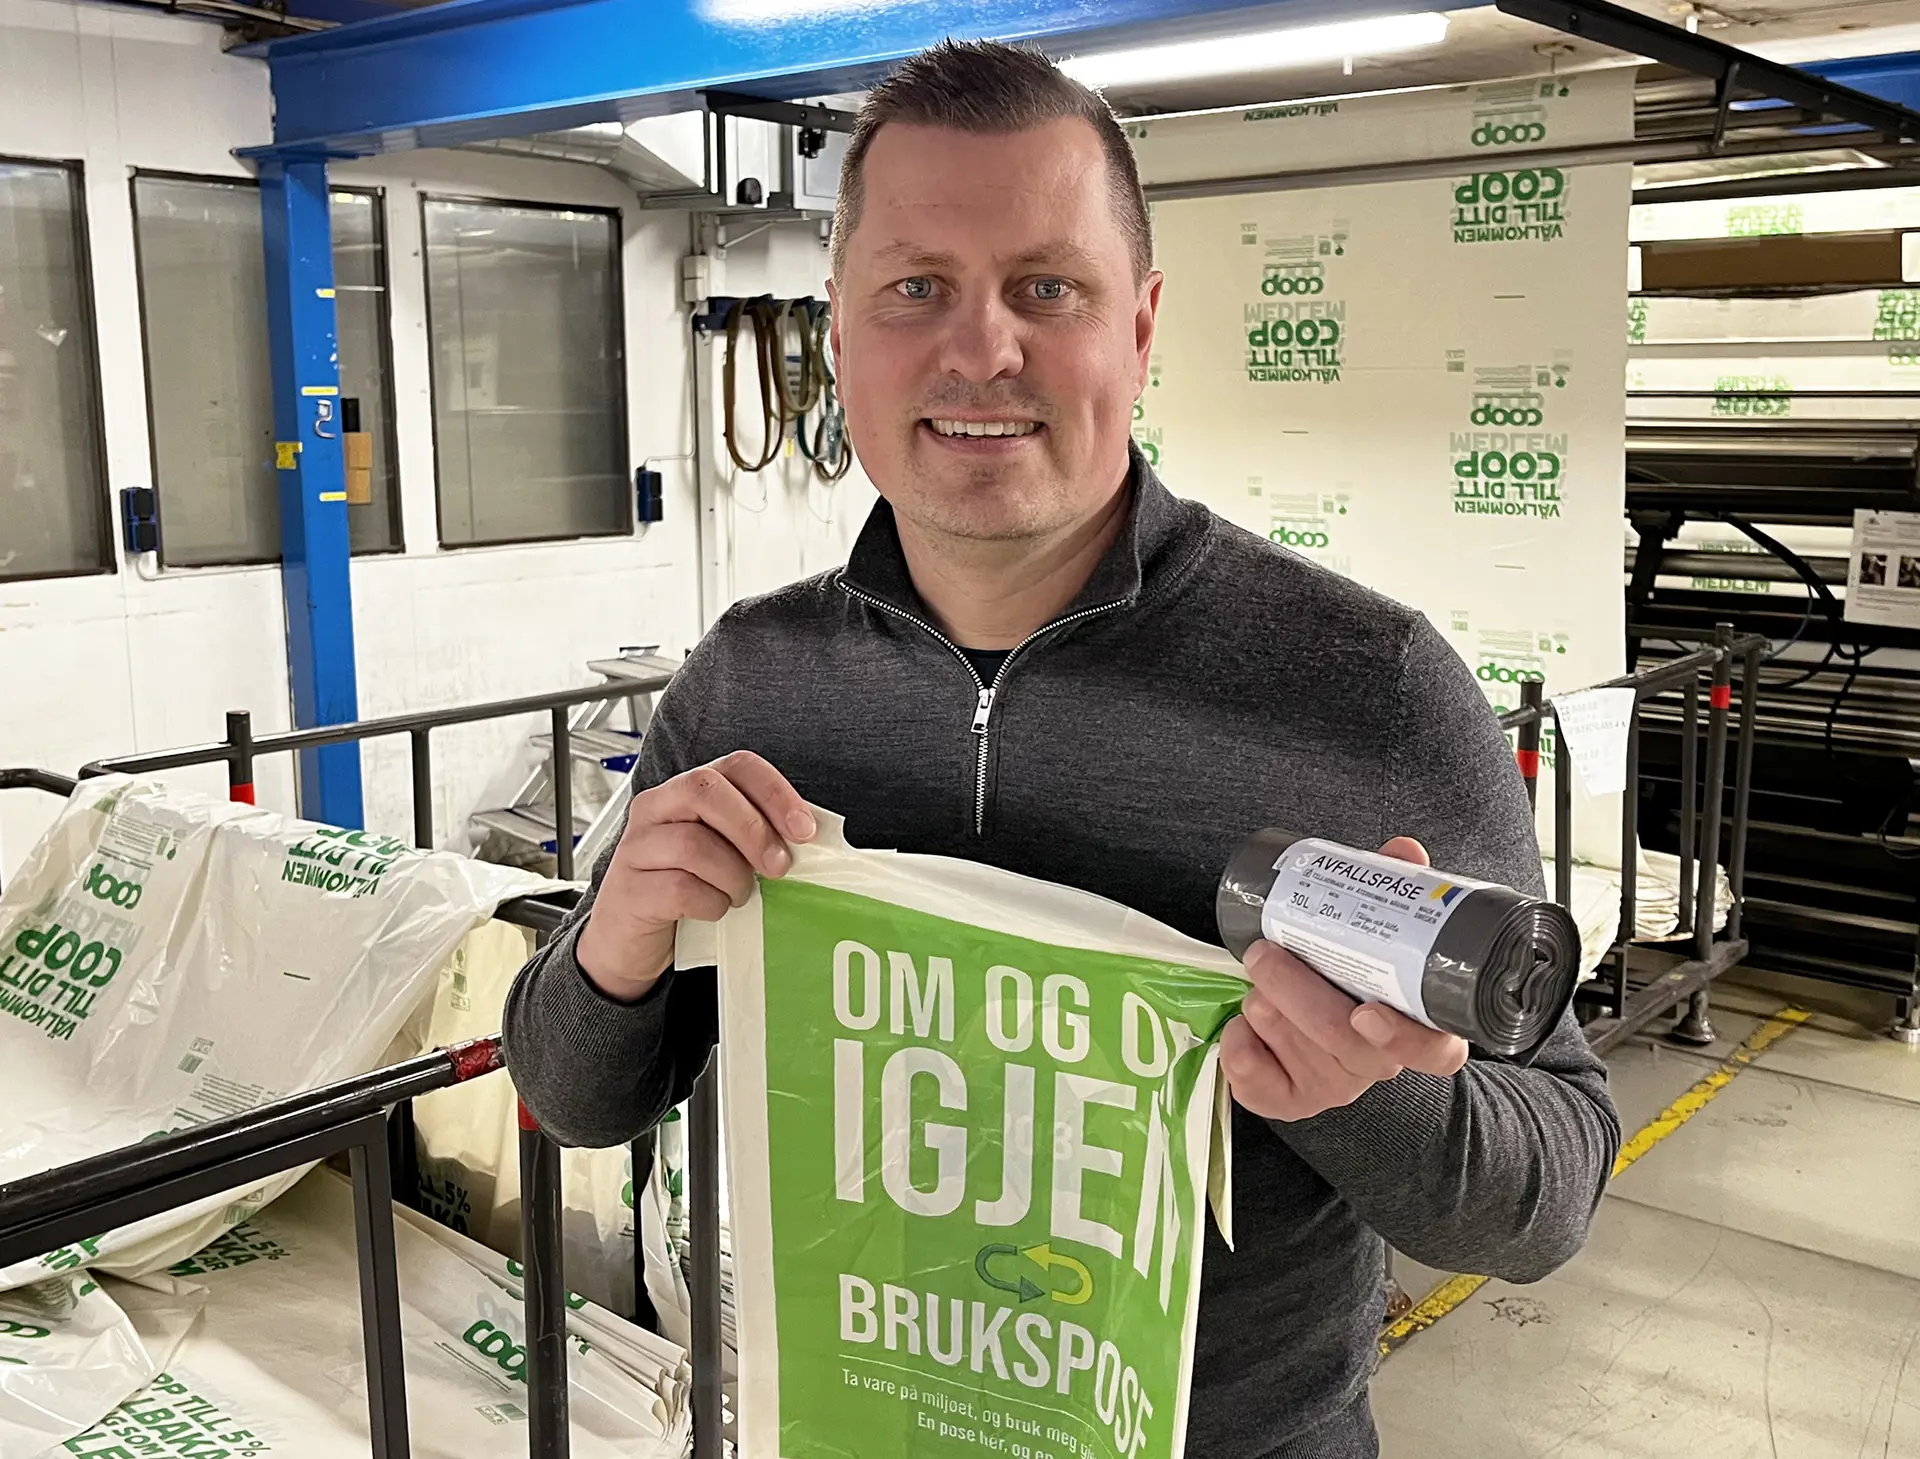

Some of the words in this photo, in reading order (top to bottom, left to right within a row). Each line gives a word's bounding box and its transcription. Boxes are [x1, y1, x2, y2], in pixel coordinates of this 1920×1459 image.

[1471, 121, 1546, 147] coop
[1455, 167, 1564, 204] COOP
[1454, 205, 1507, 226] DITT
[1513, 202, 1564, 222] TILL
[1454, 223, 1563, 243] VÄLKOMMEN
[1261, 274, 1324, 296] coop
[1249, 319, 1340, 347] COOP
[1249, 350, 1293, 367] DITT
[1297, 349, 1340, 366] TILL
[1249, 368, 1341, 385] VÄLKOMMEN
[1470, 403, 1543, 426] coop
[1454, 451, 1560, 480] COOP
[1454, 481, 1506, 498] DITT
[1511, 482, 1560, 501] TILL
[1455, 501, 1560, 520] VÄLKOMMEN
[1269, 526, 1329, 548] coop
[281, 860, 381, 899] VÄLKOMMEN
[1311, 855, 1424, 901] AVFALLSPÅSE
[1290, 891, 1309, 910] 30L
[15, 923, 122, 988] COOP
[51, 980, 97, 1020] TILL
[833, 939, 955, 1042] OM
[984, 963, 1091, 1063] OG
[463, 1319, 529, 1385] coo
[842, 1367, 858, 1387] Ta
[863, 1376, 896, 1396] vare
[900, 1384, 918, 1402] på
[982, 1409, 1001, 1428] og
[1005, 1412, 1041, 1438] bruk
[1046, 1426, 1078, 1453] meg
[173, 1395, 232, 1432] TILL
[218, 1430, 272, 1458] 5%
[917, 1411, 936, 1431] En
[940, 1416, 976, 1443] pose
[979, 1429, 1008, 1454] her,
[112, 1426, 166, 1456] SOM
